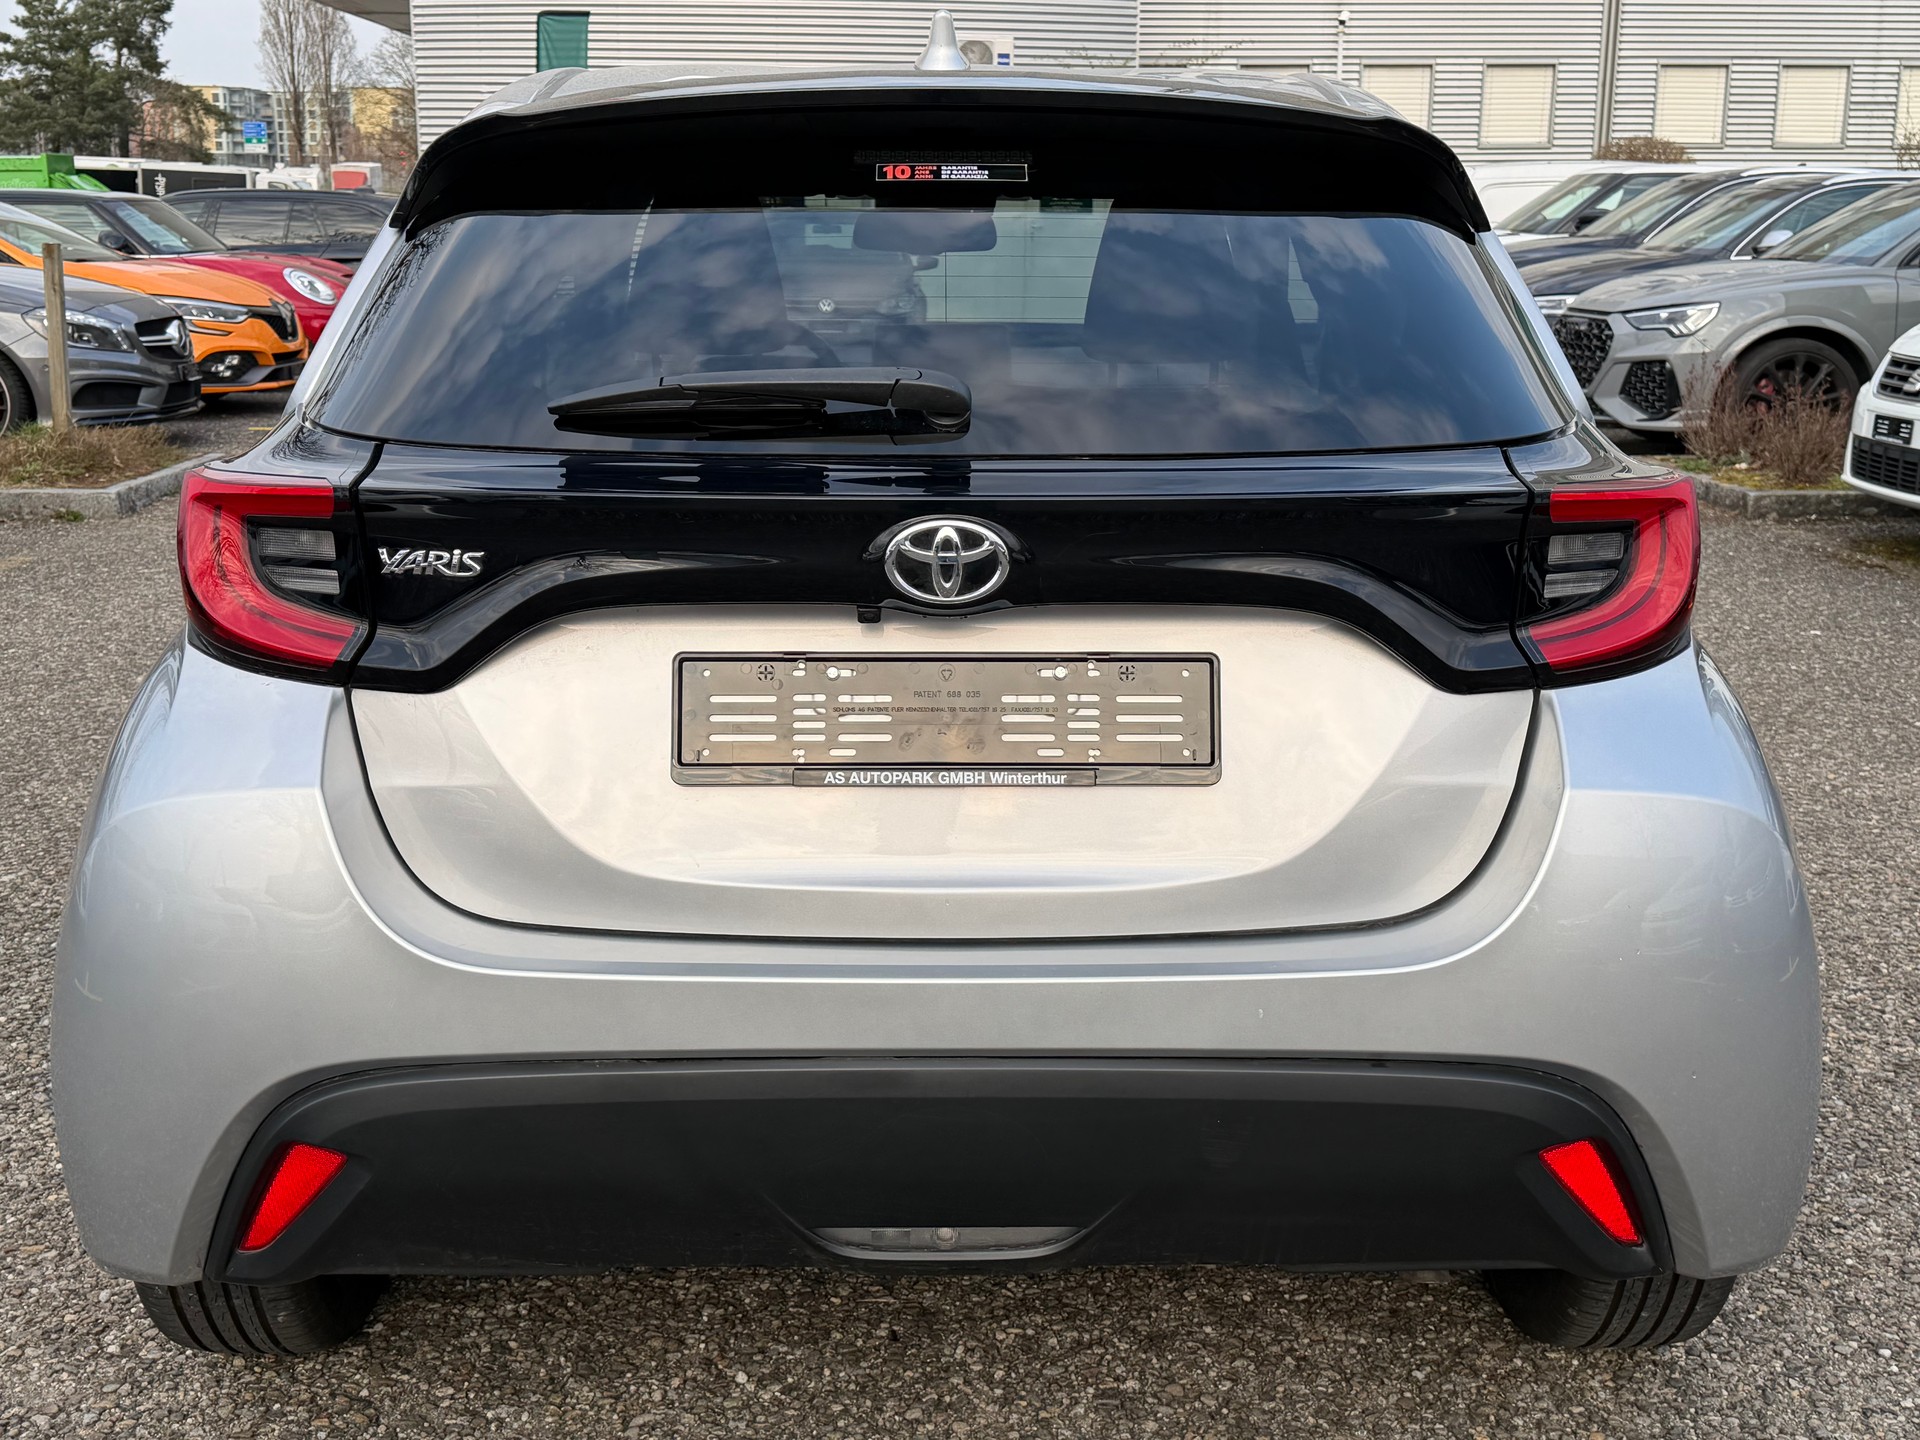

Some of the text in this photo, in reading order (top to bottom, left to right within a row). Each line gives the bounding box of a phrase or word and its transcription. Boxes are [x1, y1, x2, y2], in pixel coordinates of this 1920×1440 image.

[883, 165, 911, 179] 10
[913, 690, 981, 698] PATENT 688 035
[824, 771, 1068, 784] AS AUTOPARK GMBH Winterthur
